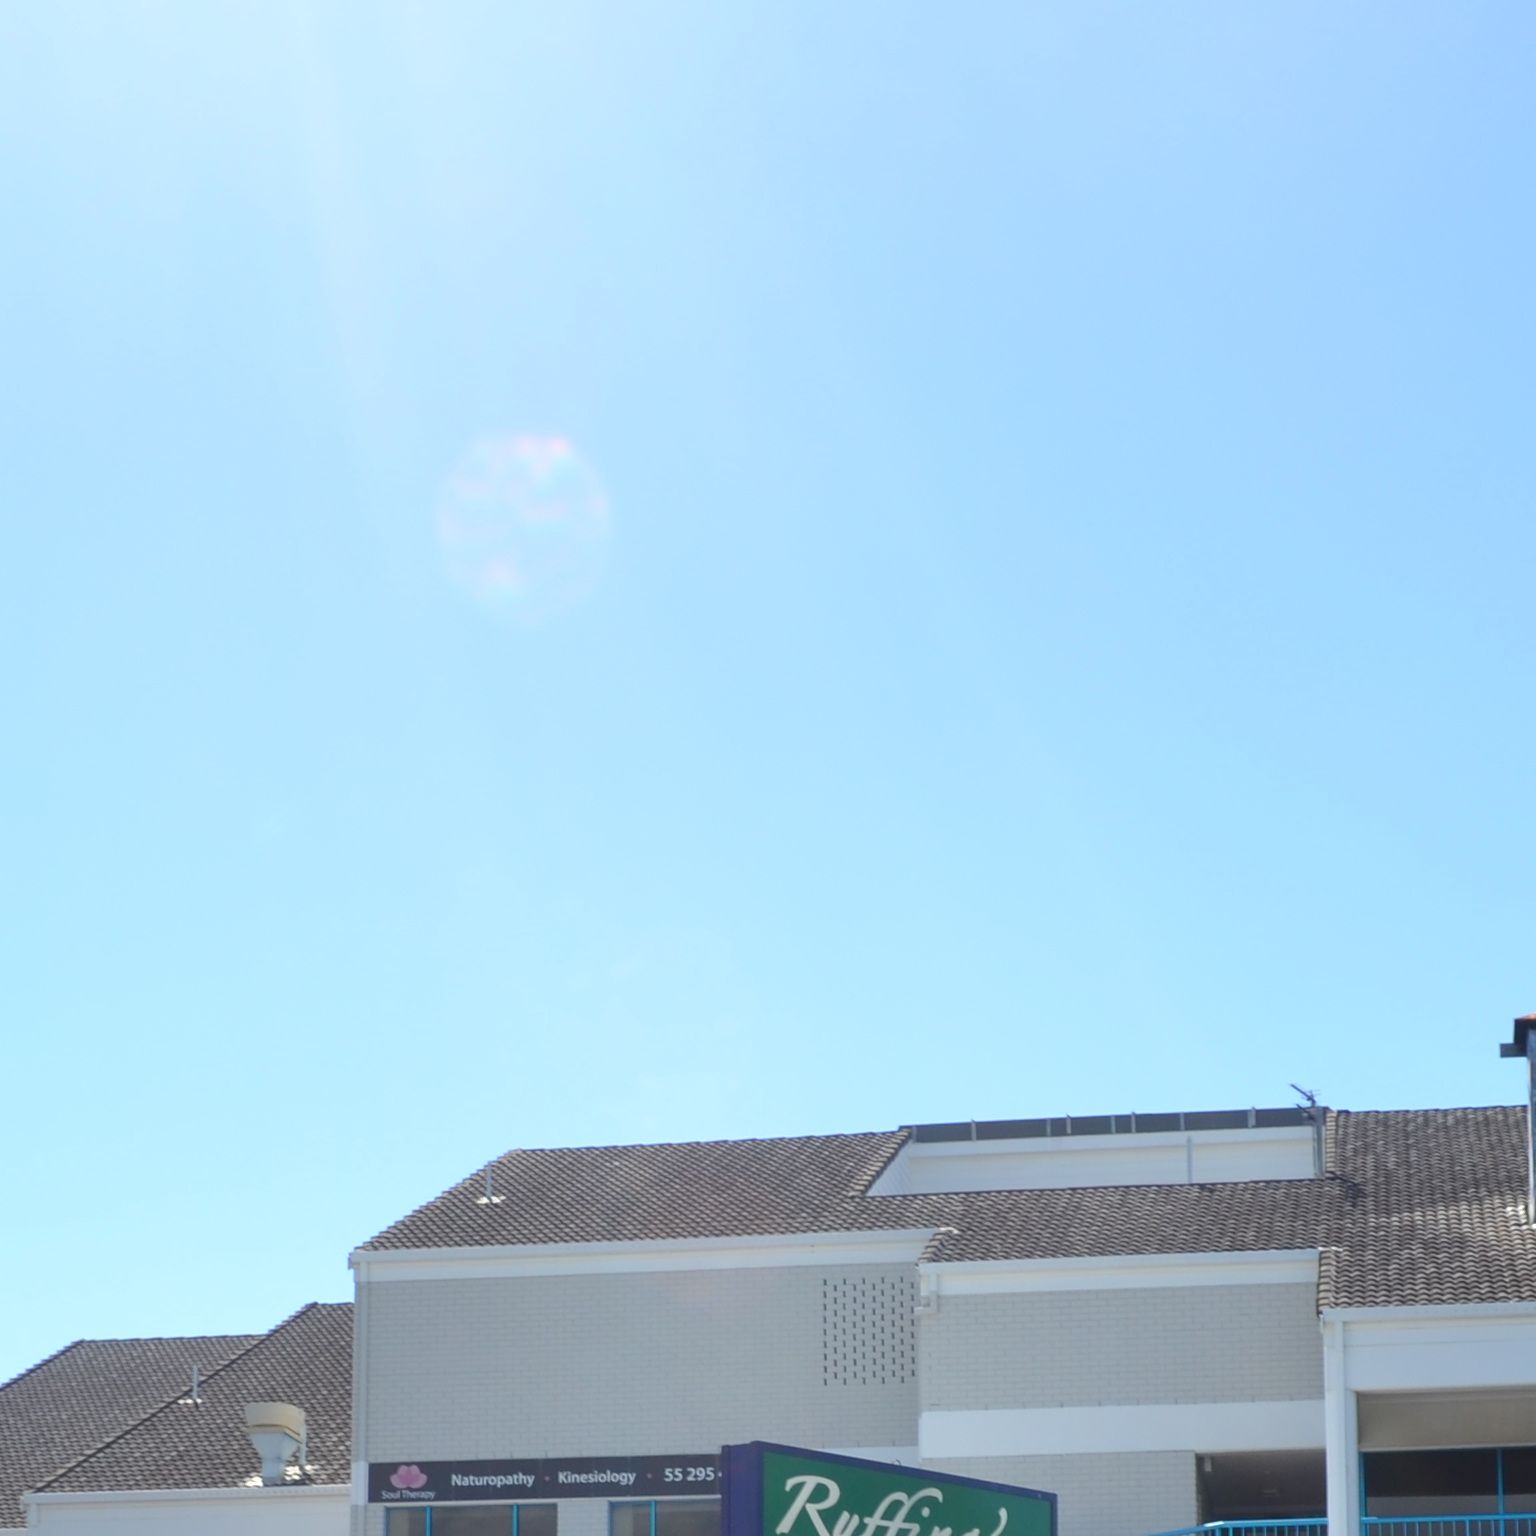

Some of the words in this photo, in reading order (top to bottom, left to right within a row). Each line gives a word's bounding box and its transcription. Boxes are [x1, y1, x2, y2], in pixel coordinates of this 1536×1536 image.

[451, 1473, 535, 1490] Naturopathy
[557, 1469, 637, 1487] Kinesiology
[686, 1466, 715, 1481] 295
